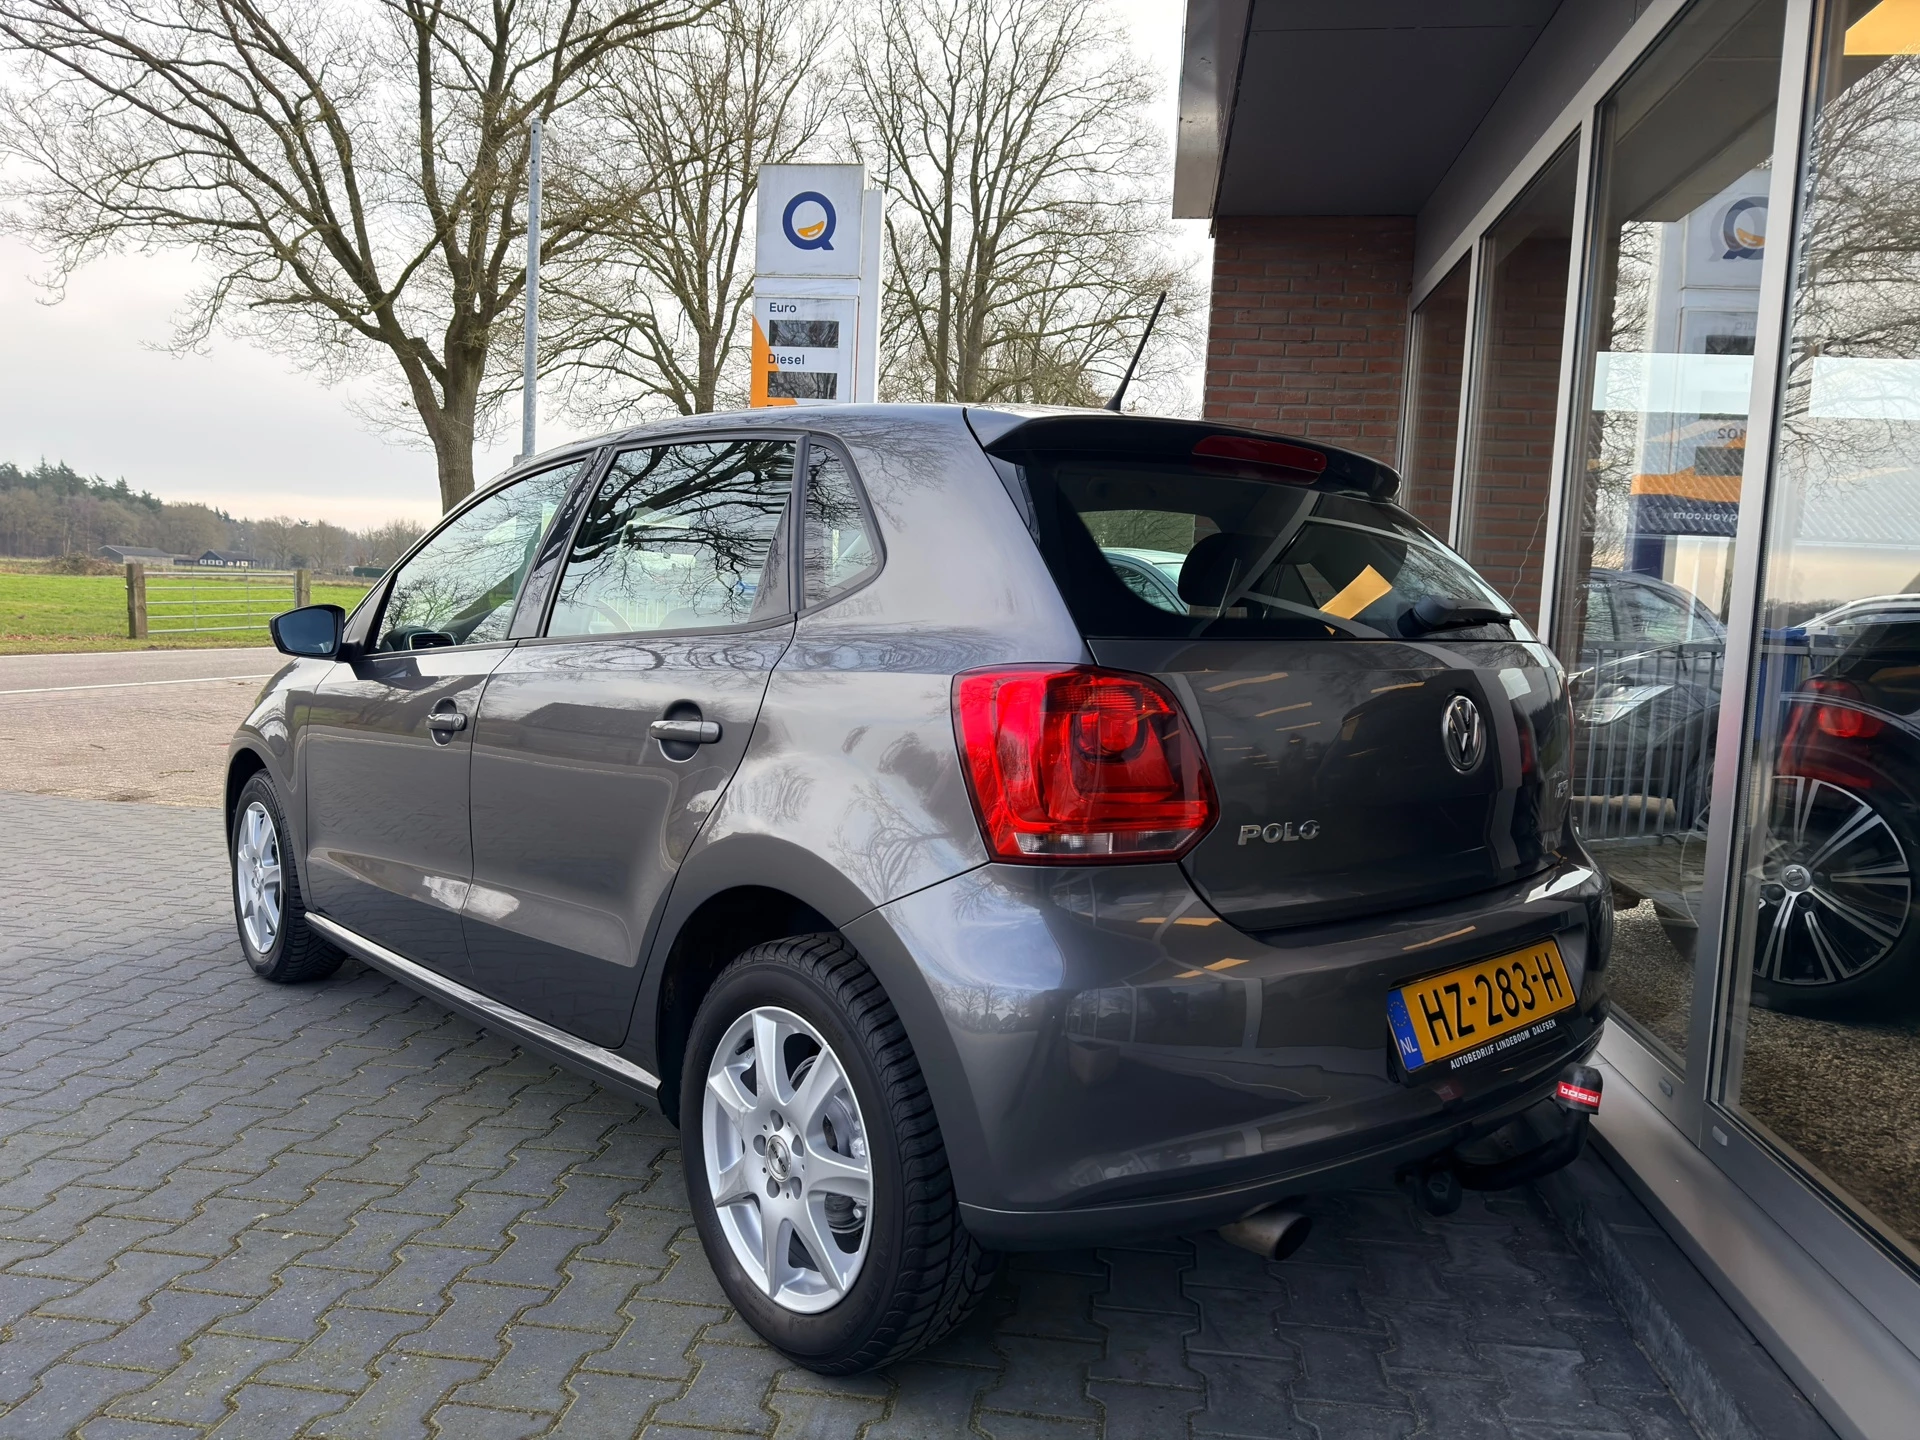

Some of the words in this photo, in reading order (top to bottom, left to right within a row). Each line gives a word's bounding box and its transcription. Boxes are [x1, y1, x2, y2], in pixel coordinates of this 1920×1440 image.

[769, 302, 797, 313] Euro
[767, 353, 805, 365] Diesel
[1238, 820, 1320, 846] POLO
[1418, 953, 1563, 1047] HZ-283-H
[1400, 1036, 1417, 1056] NL
[1450, 1044, 1495, 1070] AUTOBEDRIJF
[1496, 1029, 1531, 1051] LINDEBOOM
[1532, 1018, 1557, 1036] DALFSEN
[1561, 1085, 1598, 1104] bosal
